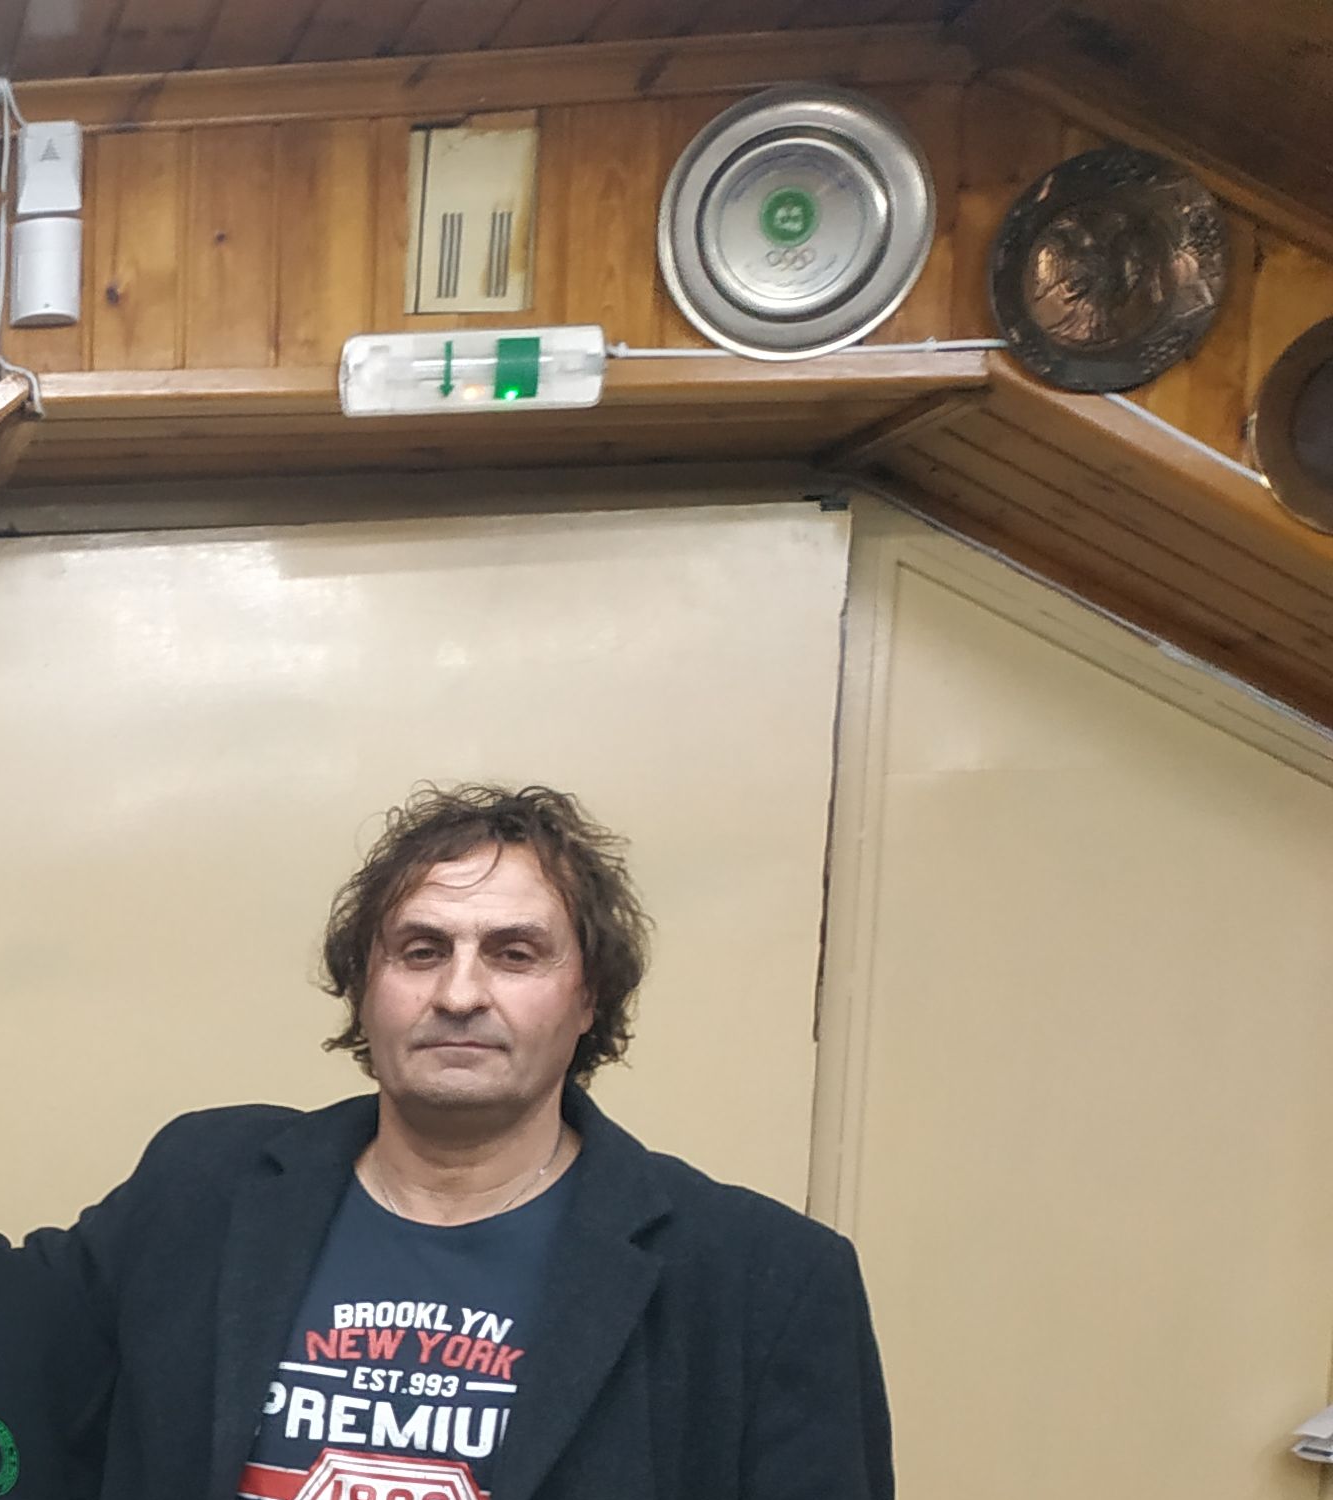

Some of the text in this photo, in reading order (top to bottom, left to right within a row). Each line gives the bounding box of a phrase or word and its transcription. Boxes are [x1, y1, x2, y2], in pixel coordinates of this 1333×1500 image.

[333, 1301, 514, 1343] BROOKLYN
[305, 1329, 525, 1380] NEW YORK
[262, 1381, 511, 1458] PREMIU
